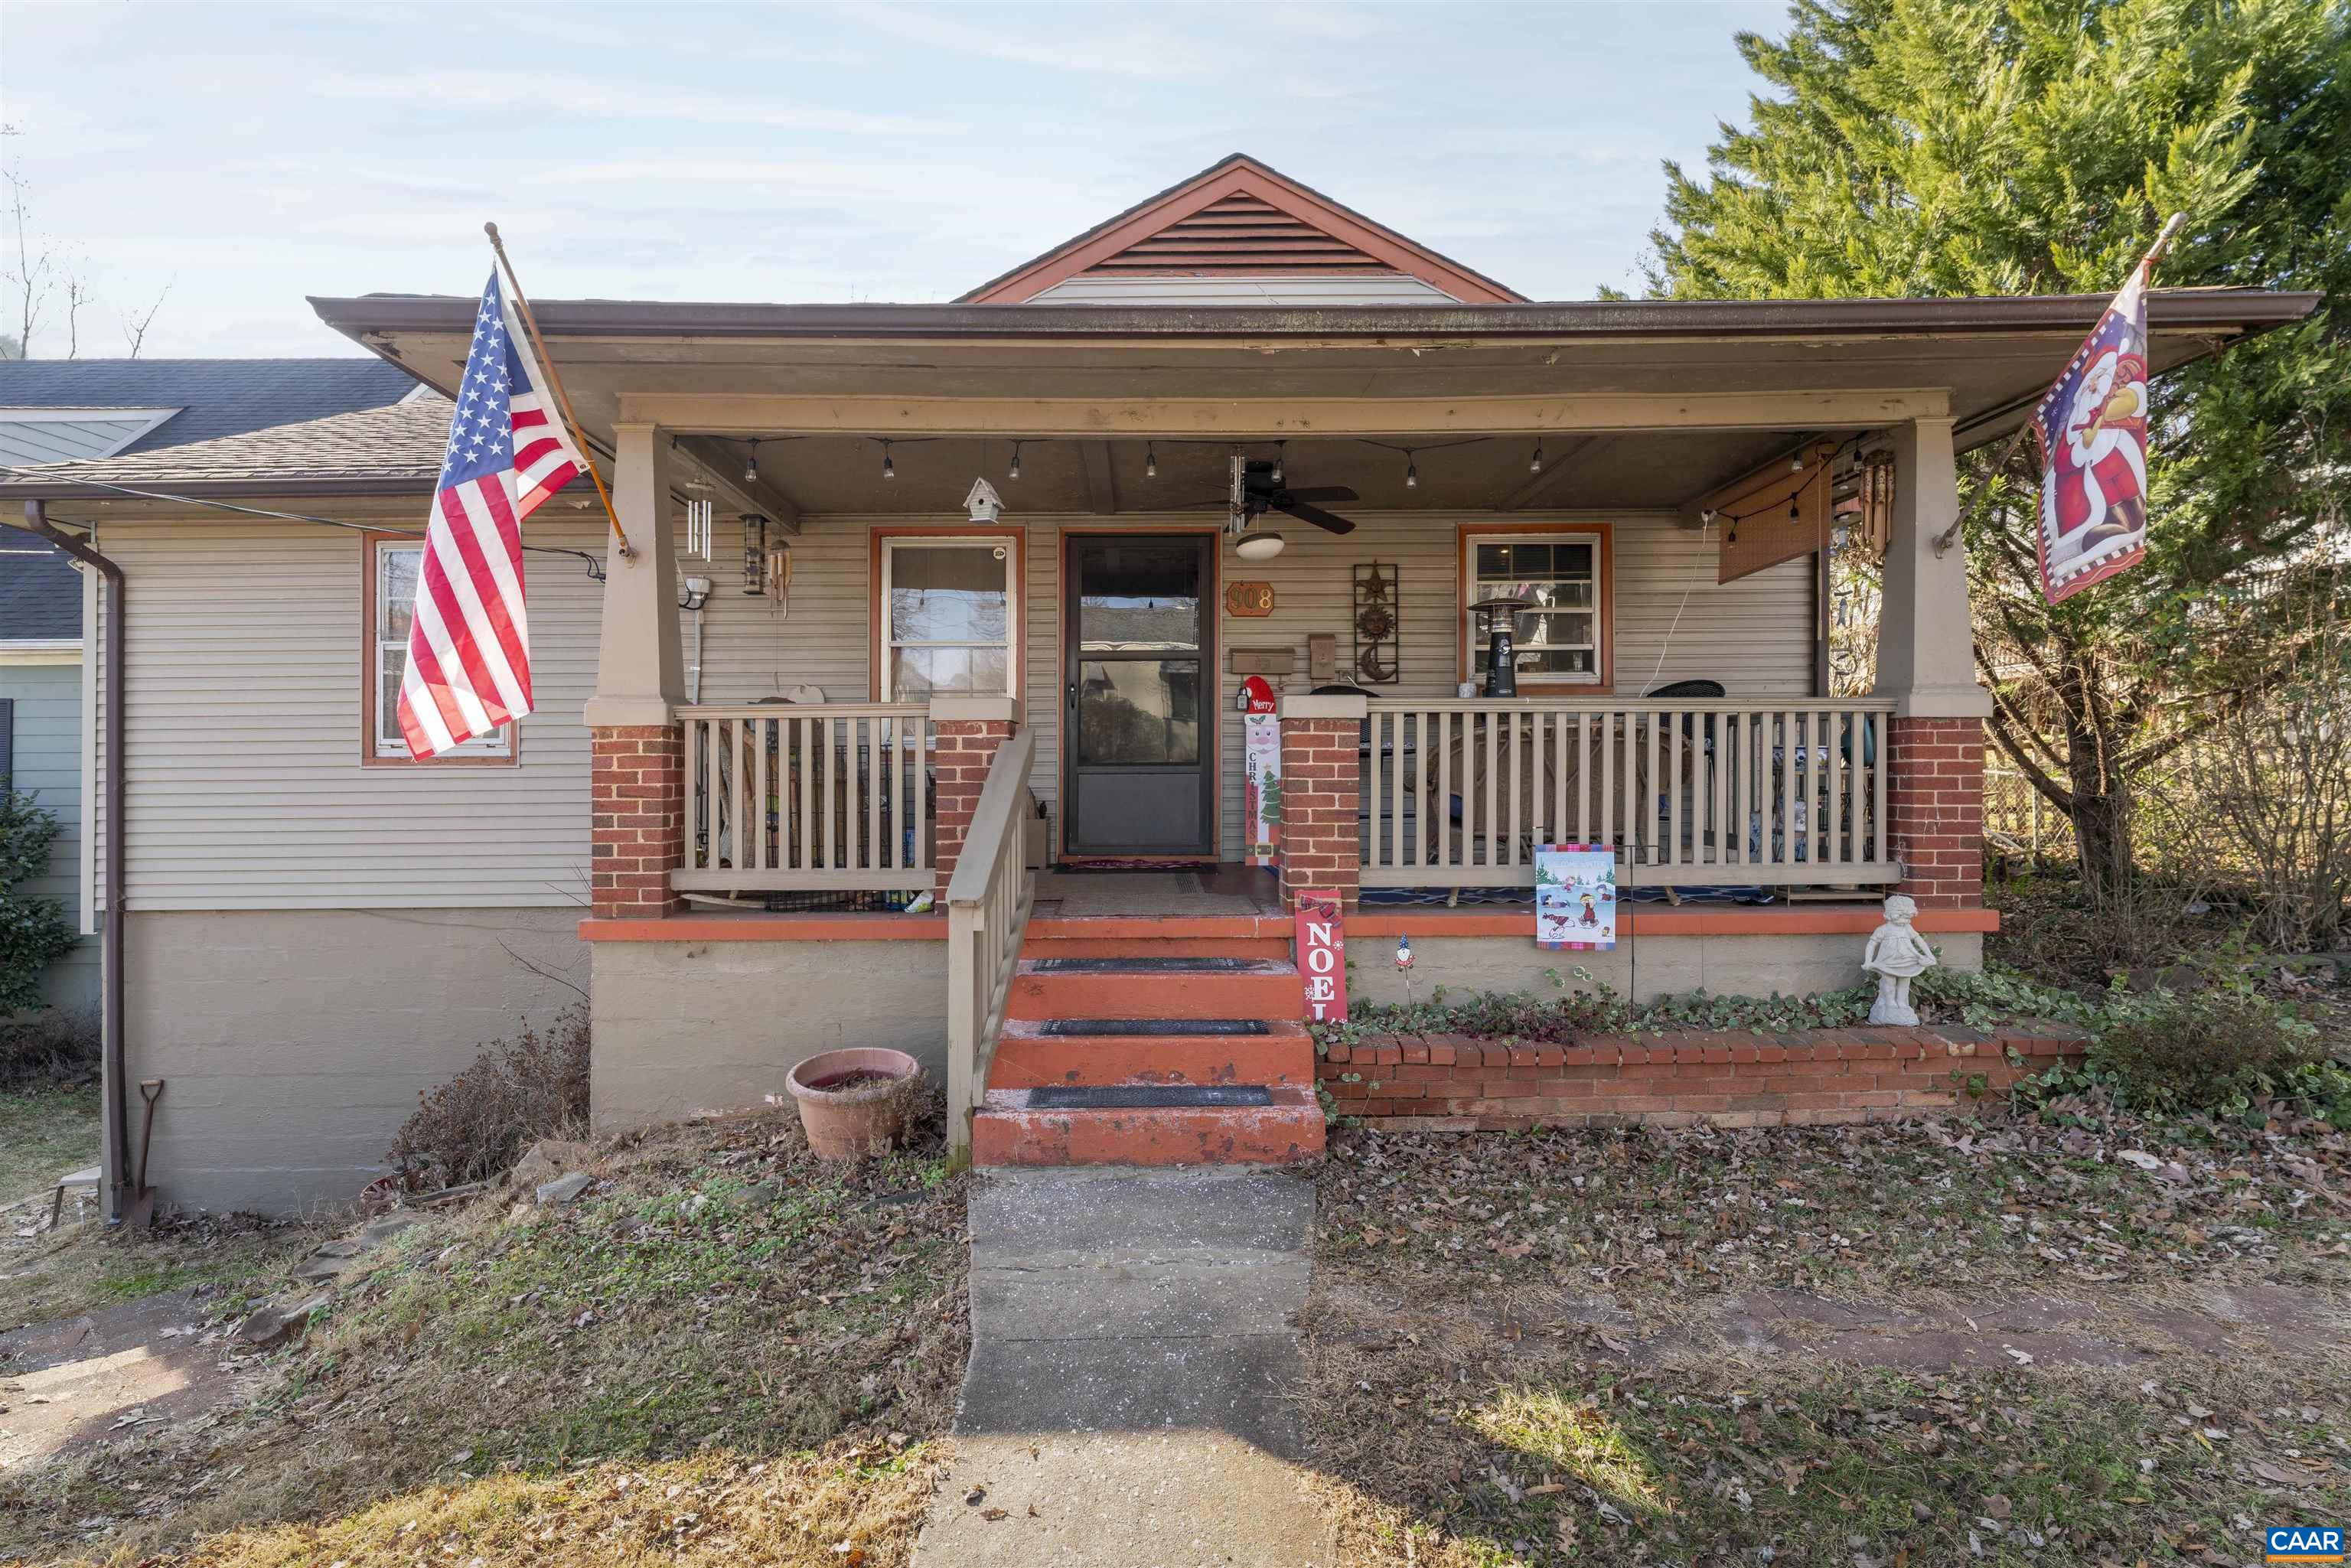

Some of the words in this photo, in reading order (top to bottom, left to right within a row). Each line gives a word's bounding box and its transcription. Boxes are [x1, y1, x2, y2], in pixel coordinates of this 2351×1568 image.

[1230, 588, 1271, 608] 908
[1252, 699, 1274, 712] Merry
[1249, 752, 1257, 839] CHRISTMAS
